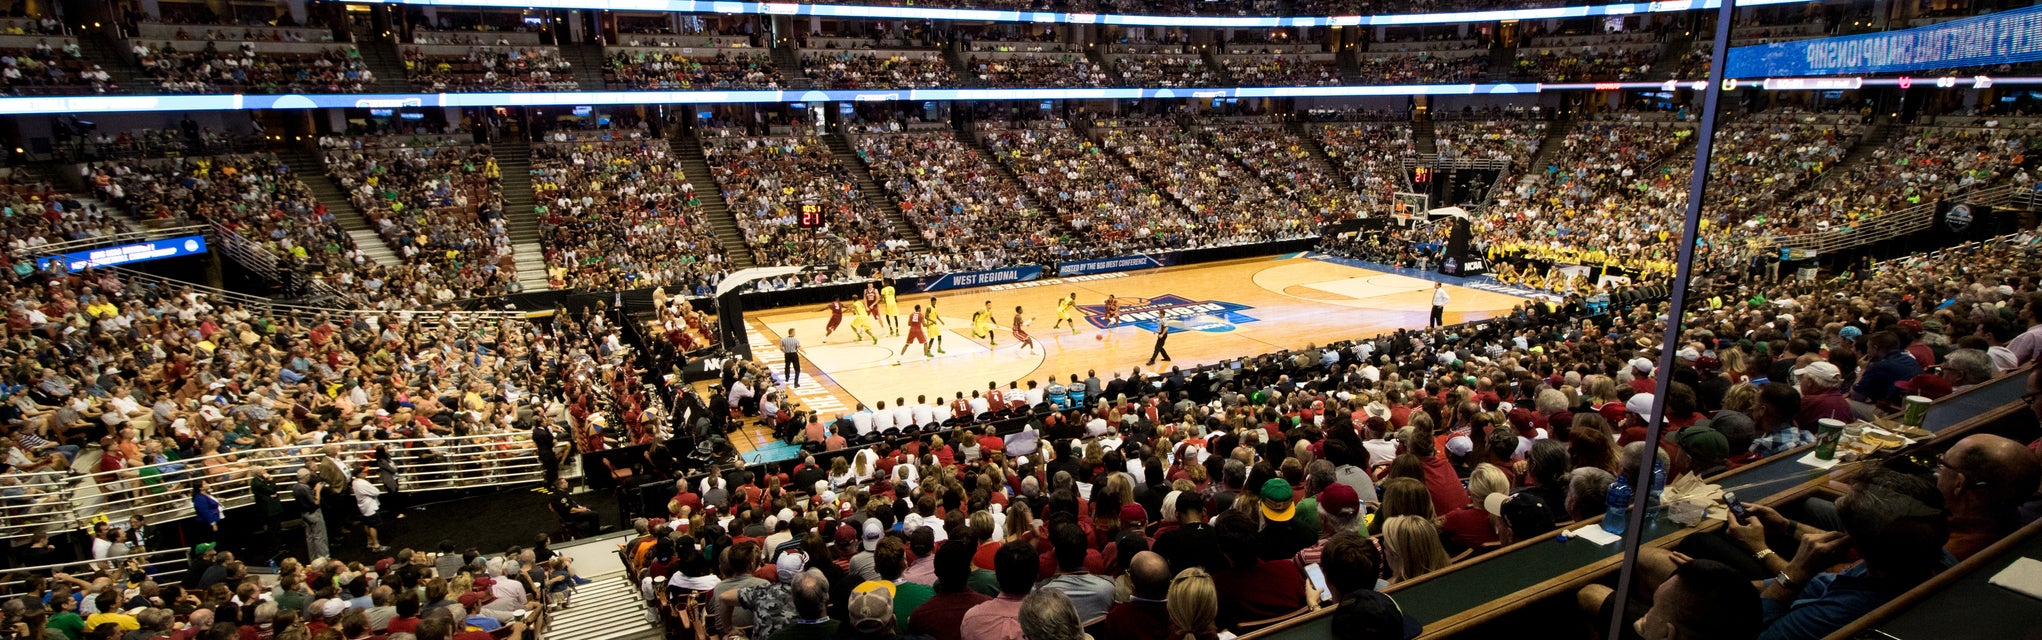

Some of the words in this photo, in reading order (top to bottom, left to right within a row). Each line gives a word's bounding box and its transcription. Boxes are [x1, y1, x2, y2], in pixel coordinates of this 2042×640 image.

[803, 212, 819, 225] 21
[1060, 265, 1079, 273] HOSTED
[1080, 263, 1087, 271] BY
[1087, 262, 1096, 270] THE
[1106, 260, 1118, 268] WEST
[1118, 258, 1147, 267] CONFERENCE
[1464, 261, 1483, 271] NCAA
[953, 275, 977, 286] WEST
[979, 270, 1018, 284] REGIONAL
[960, 403, 967, 412] 11
